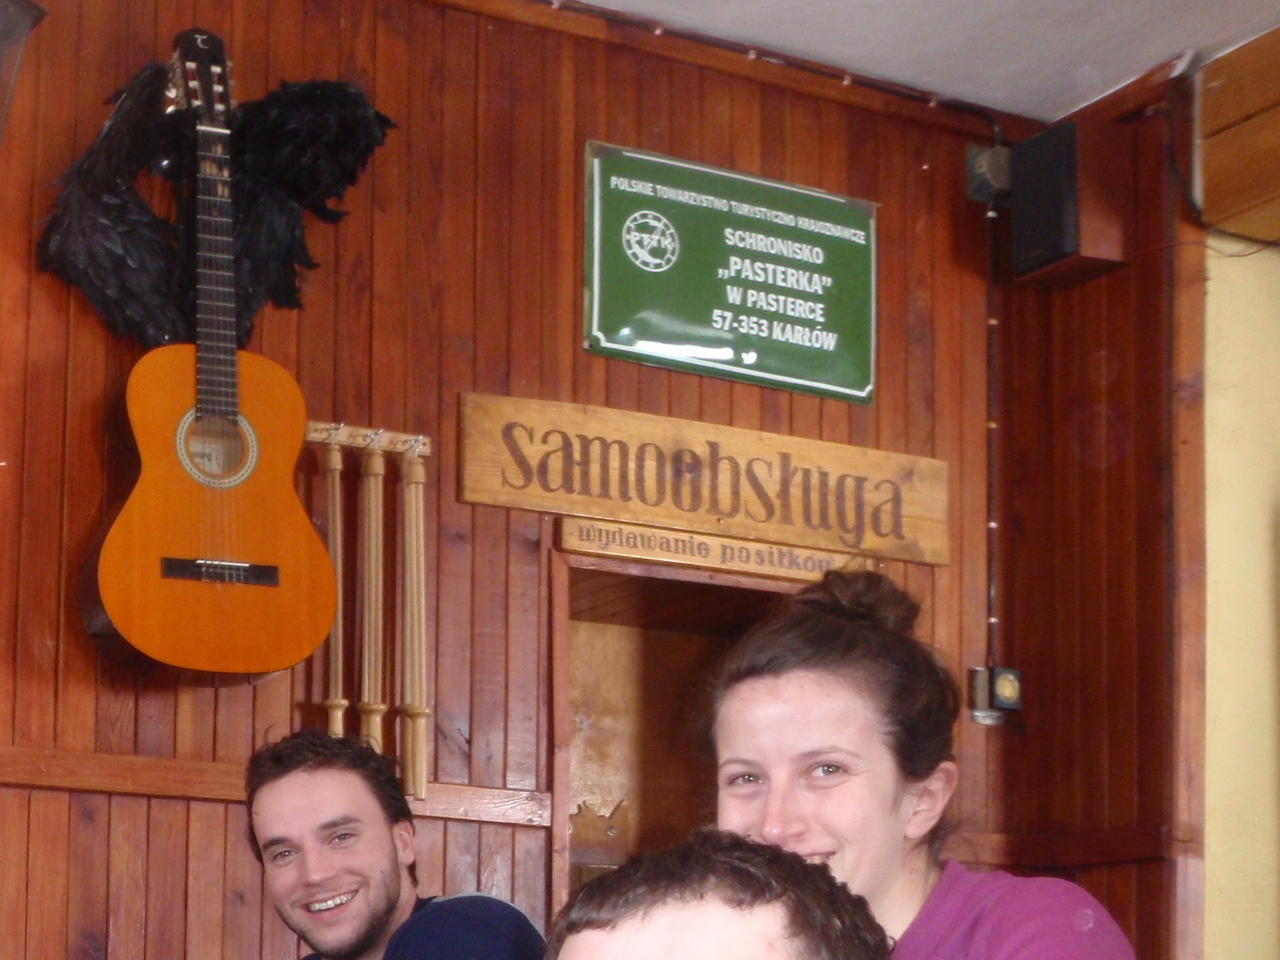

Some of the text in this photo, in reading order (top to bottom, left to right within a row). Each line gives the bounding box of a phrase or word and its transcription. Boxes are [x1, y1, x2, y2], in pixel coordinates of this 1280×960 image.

[610, 176, 654, 196] POLSKIE
[655, 185, 729, 211] TOWARZYSTWO
[729, 201, 796, 226] TURYSTYCZNO
[723, 227, 825, 265] SCHRONISKO
[726, 285, 826, 323] W PASTERCE
[711, 309, 838, 352] 57-353 KARŁÓW
[578, 524, 711, 559] wydawanie
